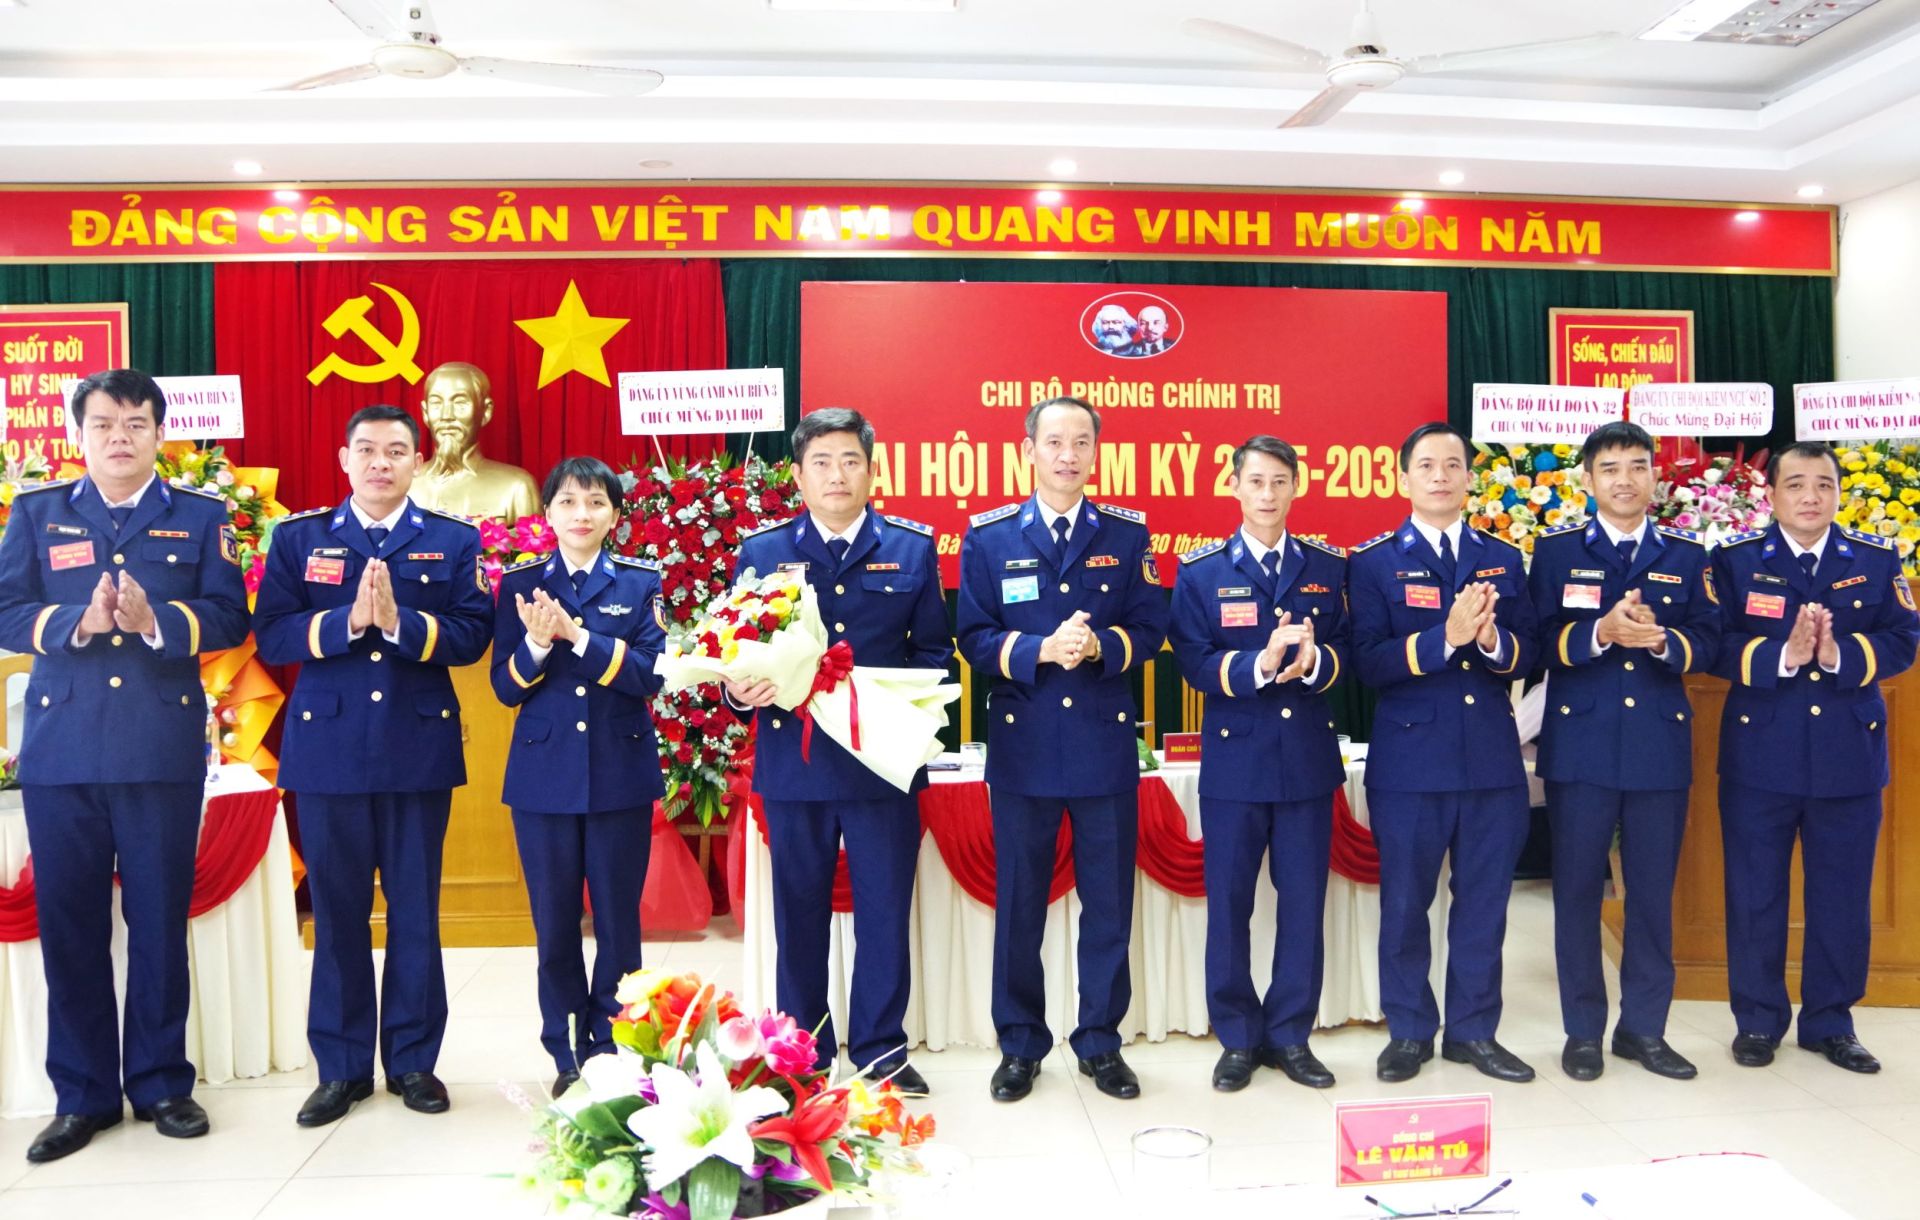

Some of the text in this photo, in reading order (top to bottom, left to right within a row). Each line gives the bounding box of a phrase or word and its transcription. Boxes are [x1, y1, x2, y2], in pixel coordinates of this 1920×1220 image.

[69, 191, 1601, 255] ĐẢNG CỘNG SẢN VIỆT NAM QUANG VINH MUÔN NĂM
[4, 333, 83, 364] SUỐT ĐỜI
[1572, 335, 1674, 366] SỐNG, CHIẾN ĐẤU
[11, 373, 33, 396] HY
[629, 383, 654, 401] ĐẢNG
[701, 381, 725, 399] CẢNH
[771, 384, 778, 397] 3
[981, 381, 1022, 407] CHI
[1071, 376, 1154, 407] PHÒNG
[1162, 378, 1236, 409] CHÍNH
[1243, 383, 1280, 414] TRỊ
[1481, 392, 1617, 415] ĐẢNG BỘ HẢI ĐOÀN 32
[1671, 390, 1686, 407] CHI
[1841, 395, 1856, 409] CHI
[1859, 391, 1876, 411] ĐỘI
[170, 411, 220, 432] ĐẠI HỘI
[641, 404, 763, 425] CHÚC MỪNG ĐẠI HỘI
[1639, 412, 1762, 430] Chúc Mừng Đại Hội
[1812, 415, 1841, 431] CHÚC
[1845, 414, 1879, 430] MỪNG
[1883, 415, 1904, 431] ĐẠI
[1521, 418, 1552, 434] MỪNG
[1556, 422, 1577, 437] ĐẠI
[870, 443, 906, 509] ẠI
[921, 430, 987, 509] HỘI
[1151, 431, 1200, 497] KỲ
[937, 533, 961, 555] Bà
[1357, 1140, 1469, 1165] LÊ VĂN TÚ
